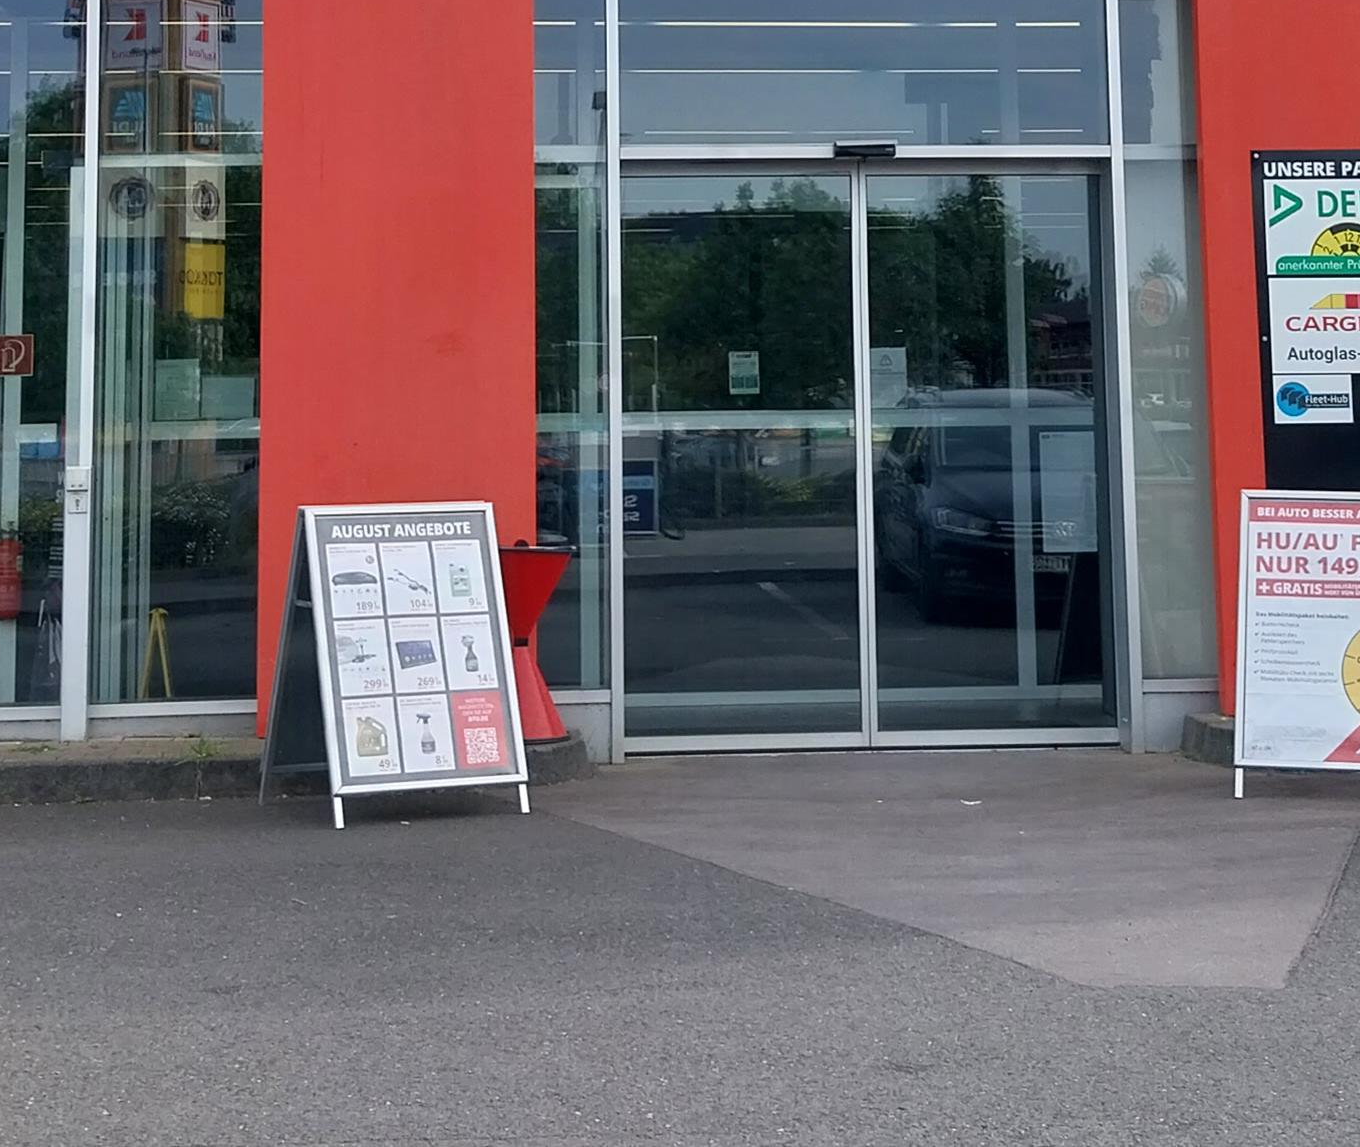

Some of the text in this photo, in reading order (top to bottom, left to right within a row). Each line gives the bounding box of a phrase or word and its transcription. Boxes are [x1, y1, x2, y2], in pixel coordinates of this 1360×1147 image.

[1263, 162, 1336, 177] UNSERE
[1278, 259, 1344, 271] anerkannter
[1257, 507, 1275, 517] BEI
[1278, 507, 1309, 518] AUTO
[1312, 508, 1354, 519] BESSER
[332, 521, 471, 539] AUGUST ANGEBOTE
[1256, 555, 1310, 574] NUR
[1273, 582, 1323, 595] GRATIS
